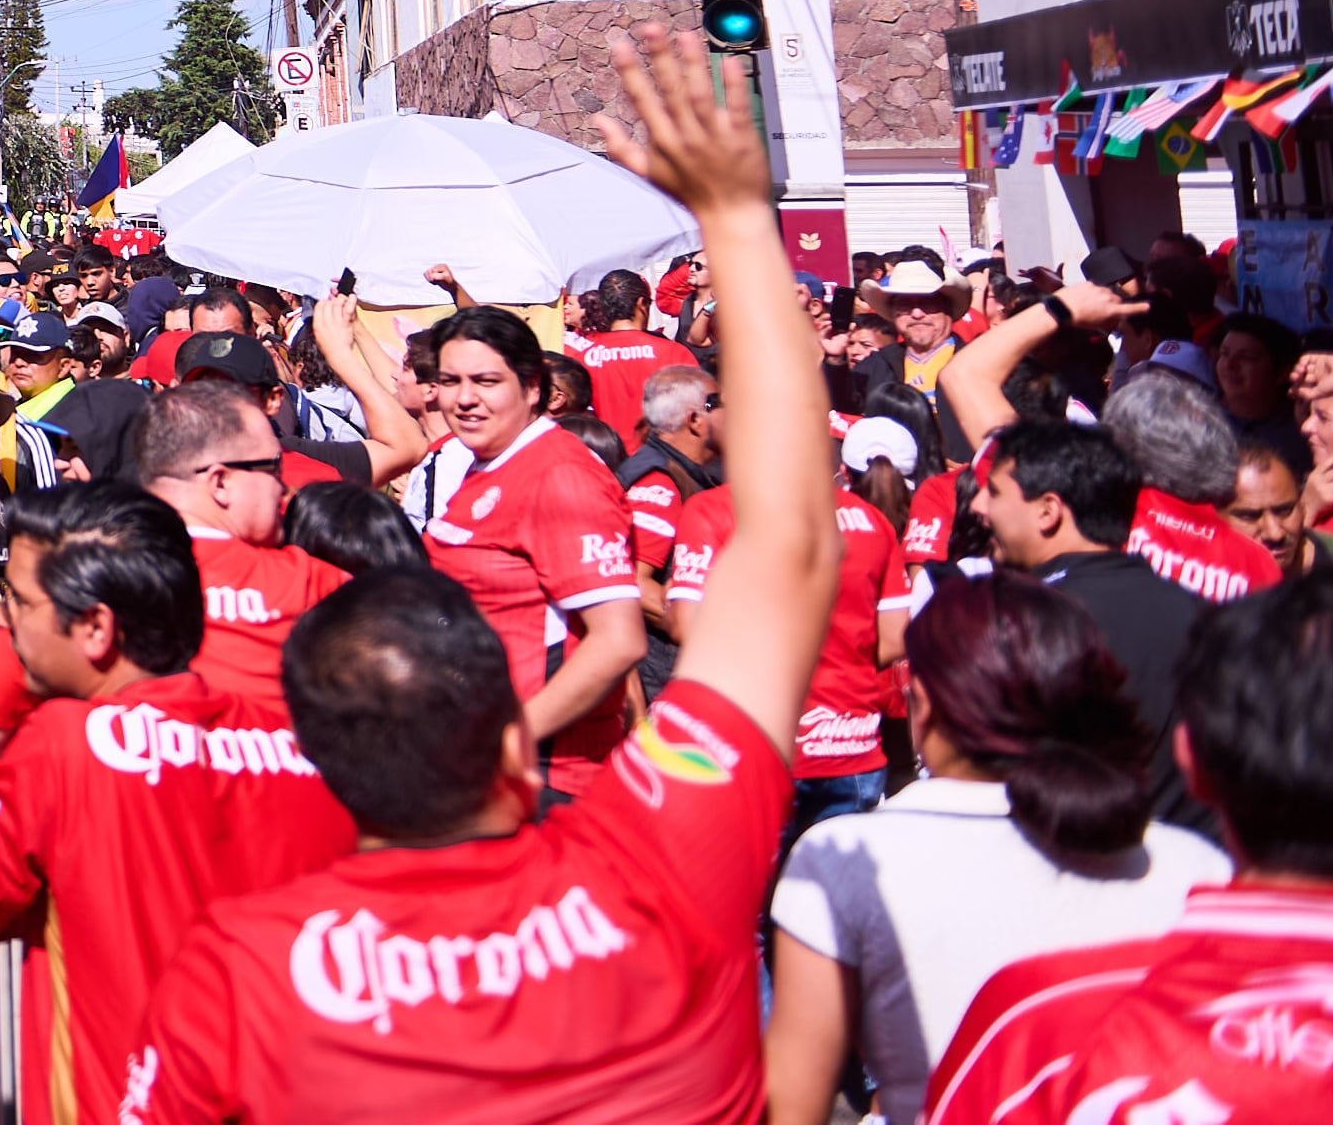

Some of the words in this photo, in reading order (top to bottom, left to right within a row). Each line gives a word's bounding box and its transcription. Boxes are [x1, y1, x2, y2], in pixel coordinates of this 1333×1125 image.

[961, 51, 1007, 94] TECATE
[297, 117, 308, 130] E
[772, 132, 828, 140] SEGURIDAD
[583, 344, 656, 368] Corona
[580, 532, 632, 563] Red
[289, 885, 632, 1035] Corona
